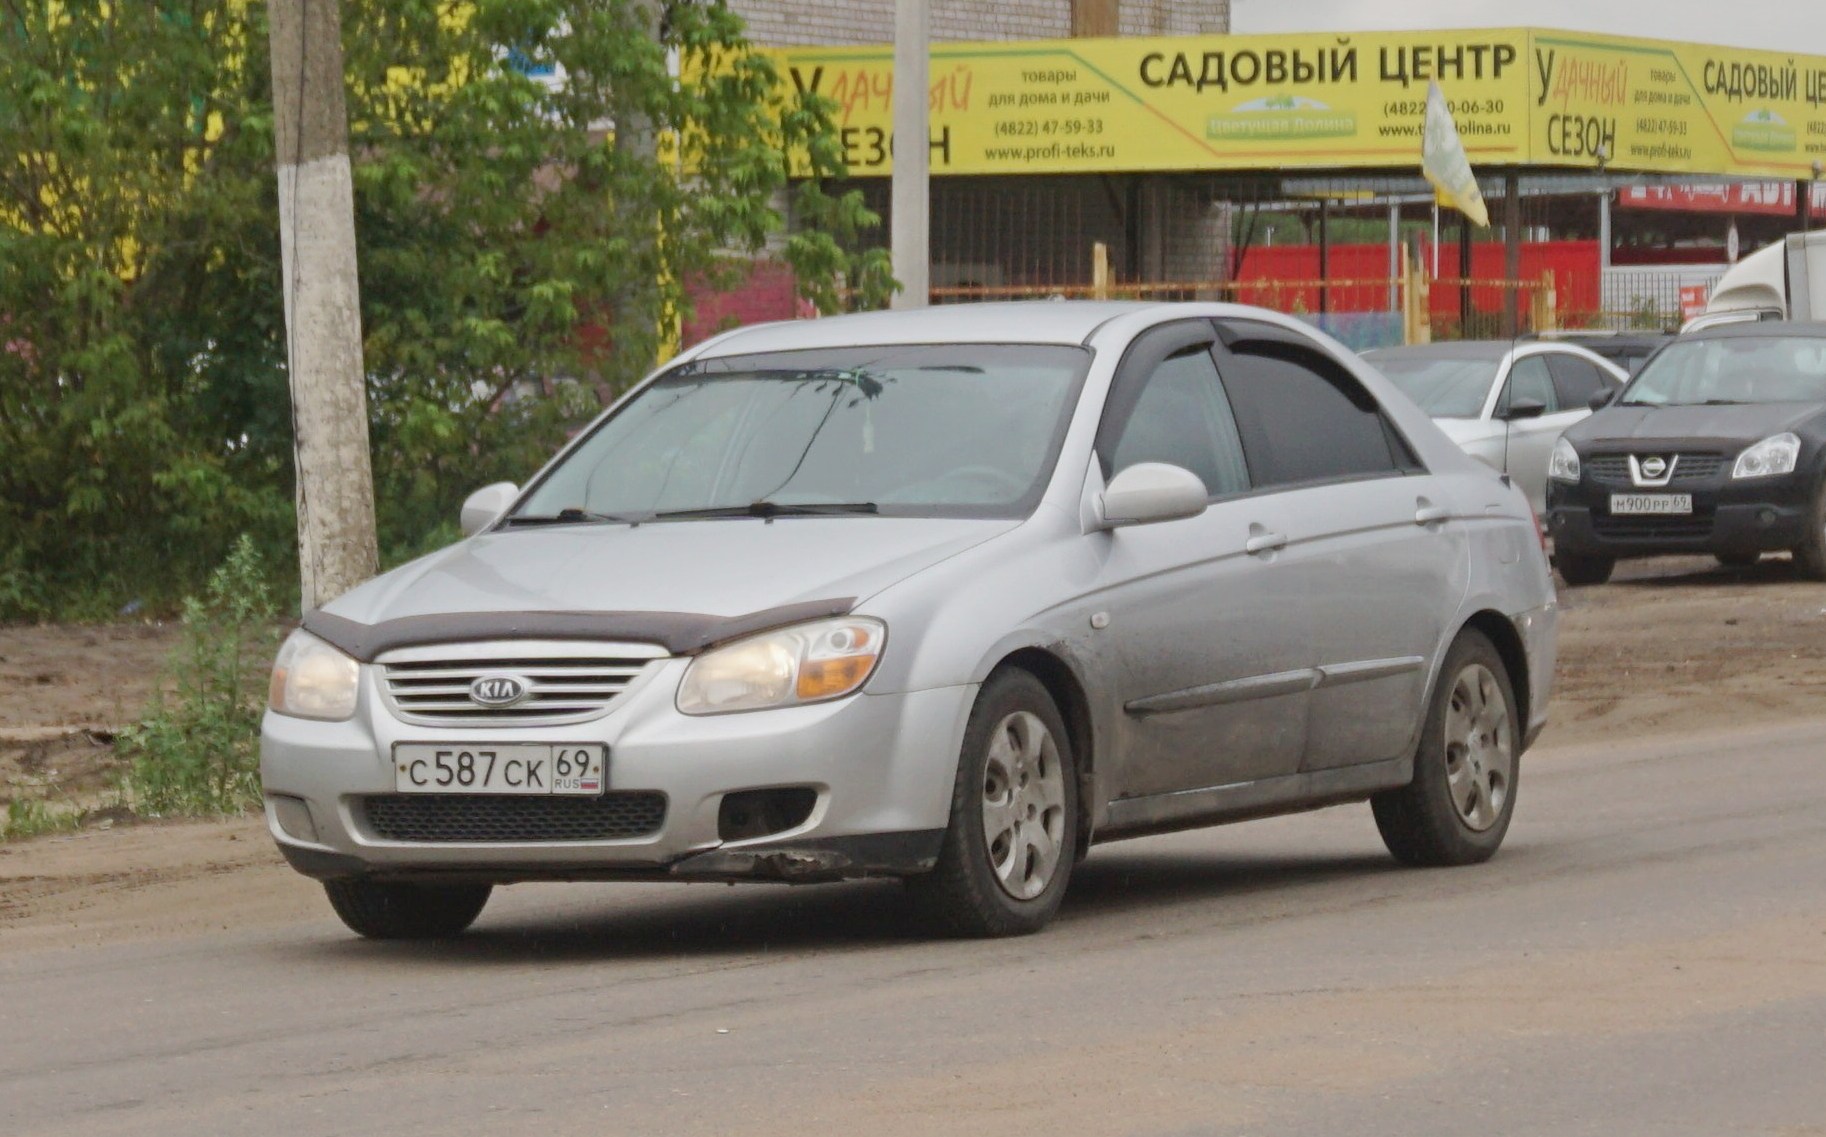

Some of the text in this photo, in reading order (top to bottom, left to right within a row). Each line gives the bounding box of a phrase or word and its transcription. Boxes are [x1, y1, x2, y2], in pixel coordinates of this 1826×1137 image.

[1139, 37, 1517, 94] САДОВЫЙ ЦЕНТР
[1022, 70, 1077, 85] товары
[1703, 58, 1798, 104] САДОВЫЙ
[988, 91, 1111, 108] для дома и дачи
[994, 118, 1104, 137] (4822) 47-59-33
[1547, 113, 1616, 161] СЕЗОН
[834, 126, 950, 167] ЕЗН
[984, 141, 1116, 162] www.profi-teks.ru
[479, 681, 516, 698] KIA
[556, 749, 590, 777] 69
[554, 778, 580, 789] RUS
